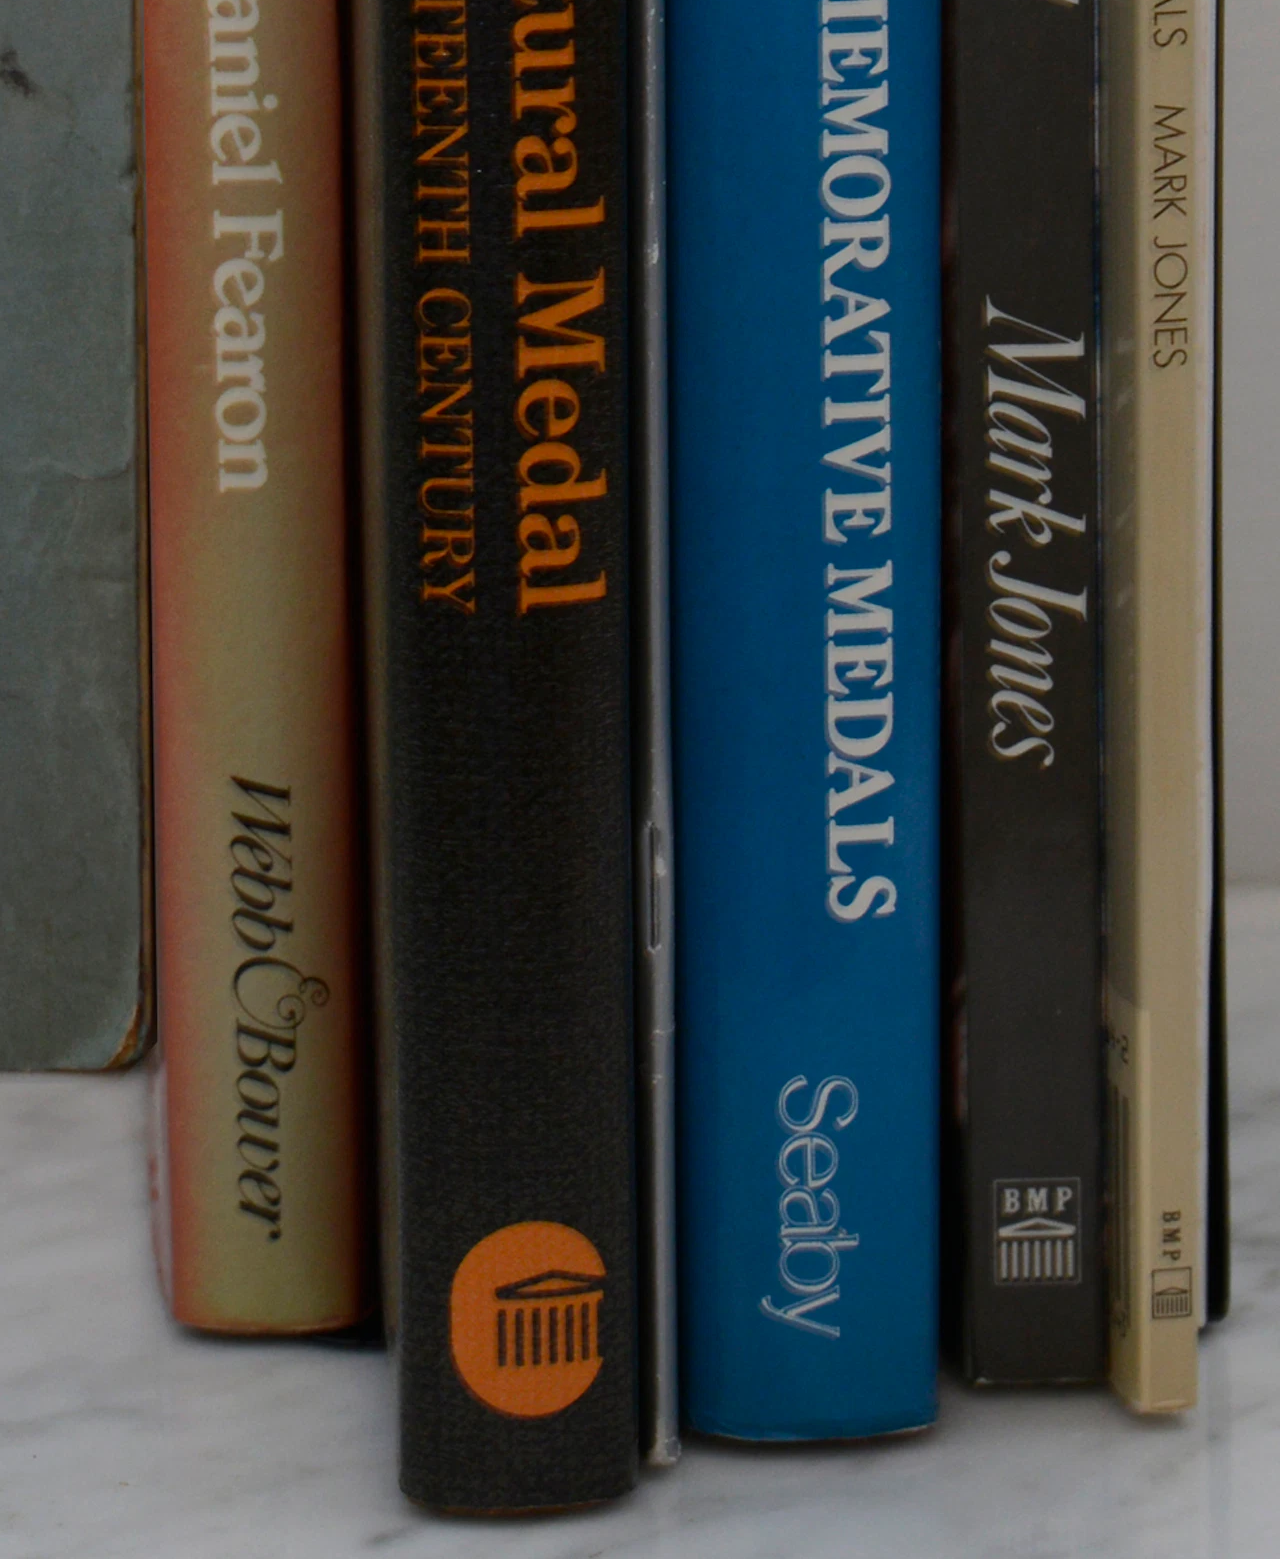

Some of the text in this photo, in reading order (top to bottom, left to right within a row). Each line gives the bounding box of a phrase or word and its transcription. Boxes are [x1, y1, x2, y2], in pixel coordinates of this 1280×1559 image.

[213, 209, 285, 494] Fearon
[1153, 103, 1189, 369] MARK JONES
[414, 289, 477, 615] CENTURY
[514, 266, 607, 615] Medal
[982, 293, 1088, 768] Mark Jones
[824, 561, 896, 924] MEDALS
[760, 1074, 859, 1339] Seaby
[1003, 1186, 1074, 1215] BMP
